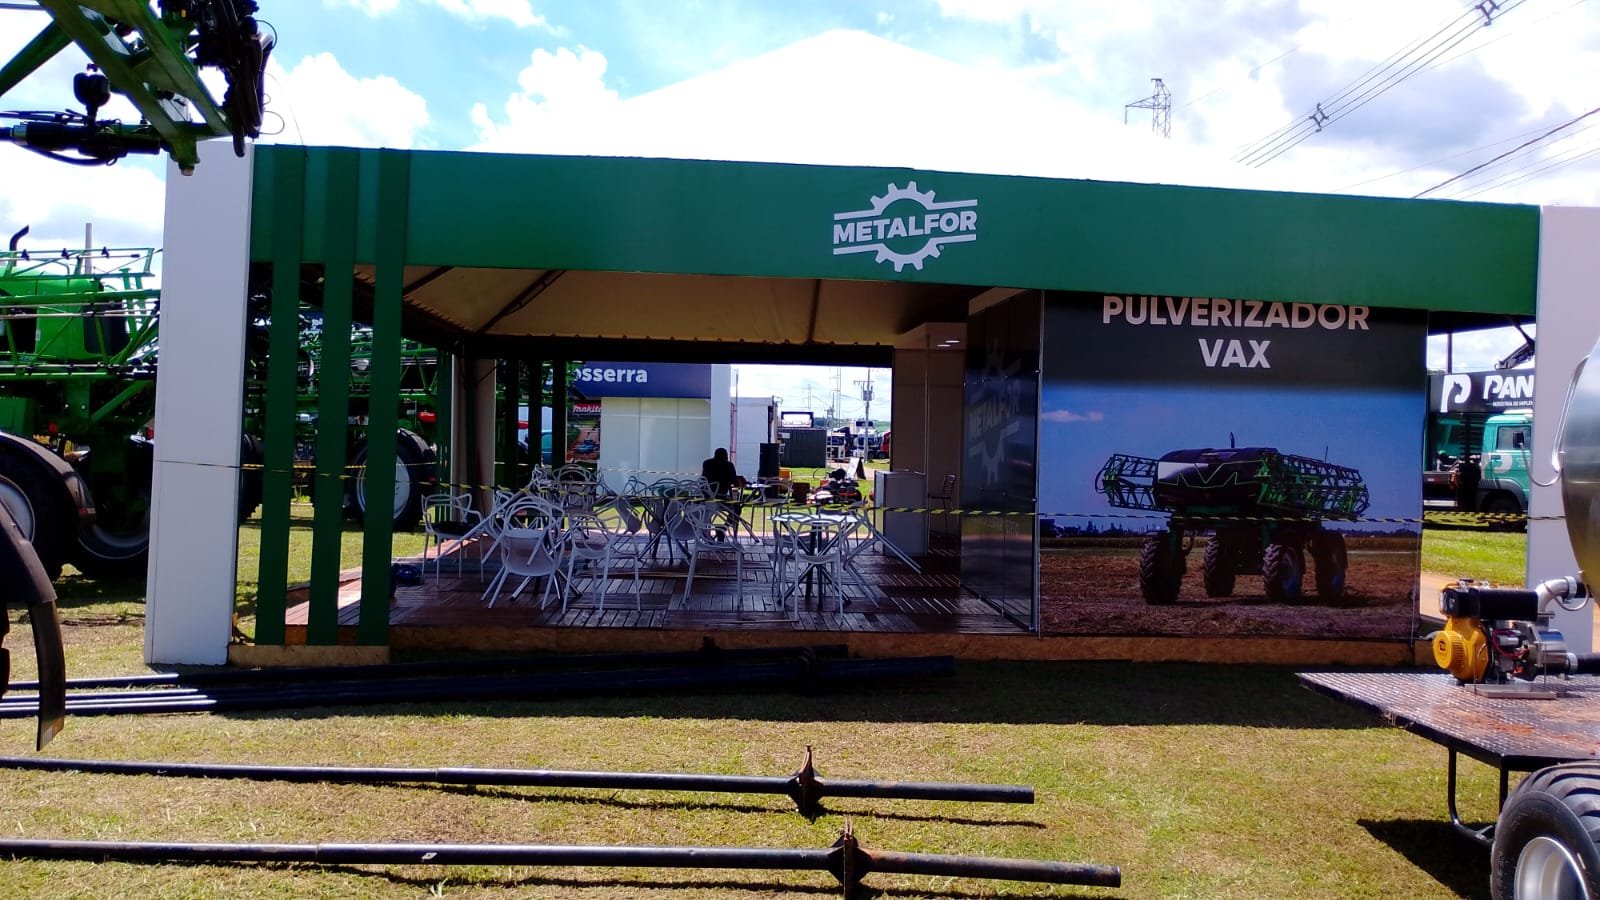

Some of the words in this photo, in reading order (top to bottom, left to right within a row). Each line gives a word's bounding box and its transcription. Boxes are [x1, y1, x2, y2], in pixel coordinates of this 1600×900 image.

[833, 210, 978, 245] METALFOR
[1102, 296, 1370, 330] PULVERIZADOR
[1198, 338, 1271, 369] VAX
